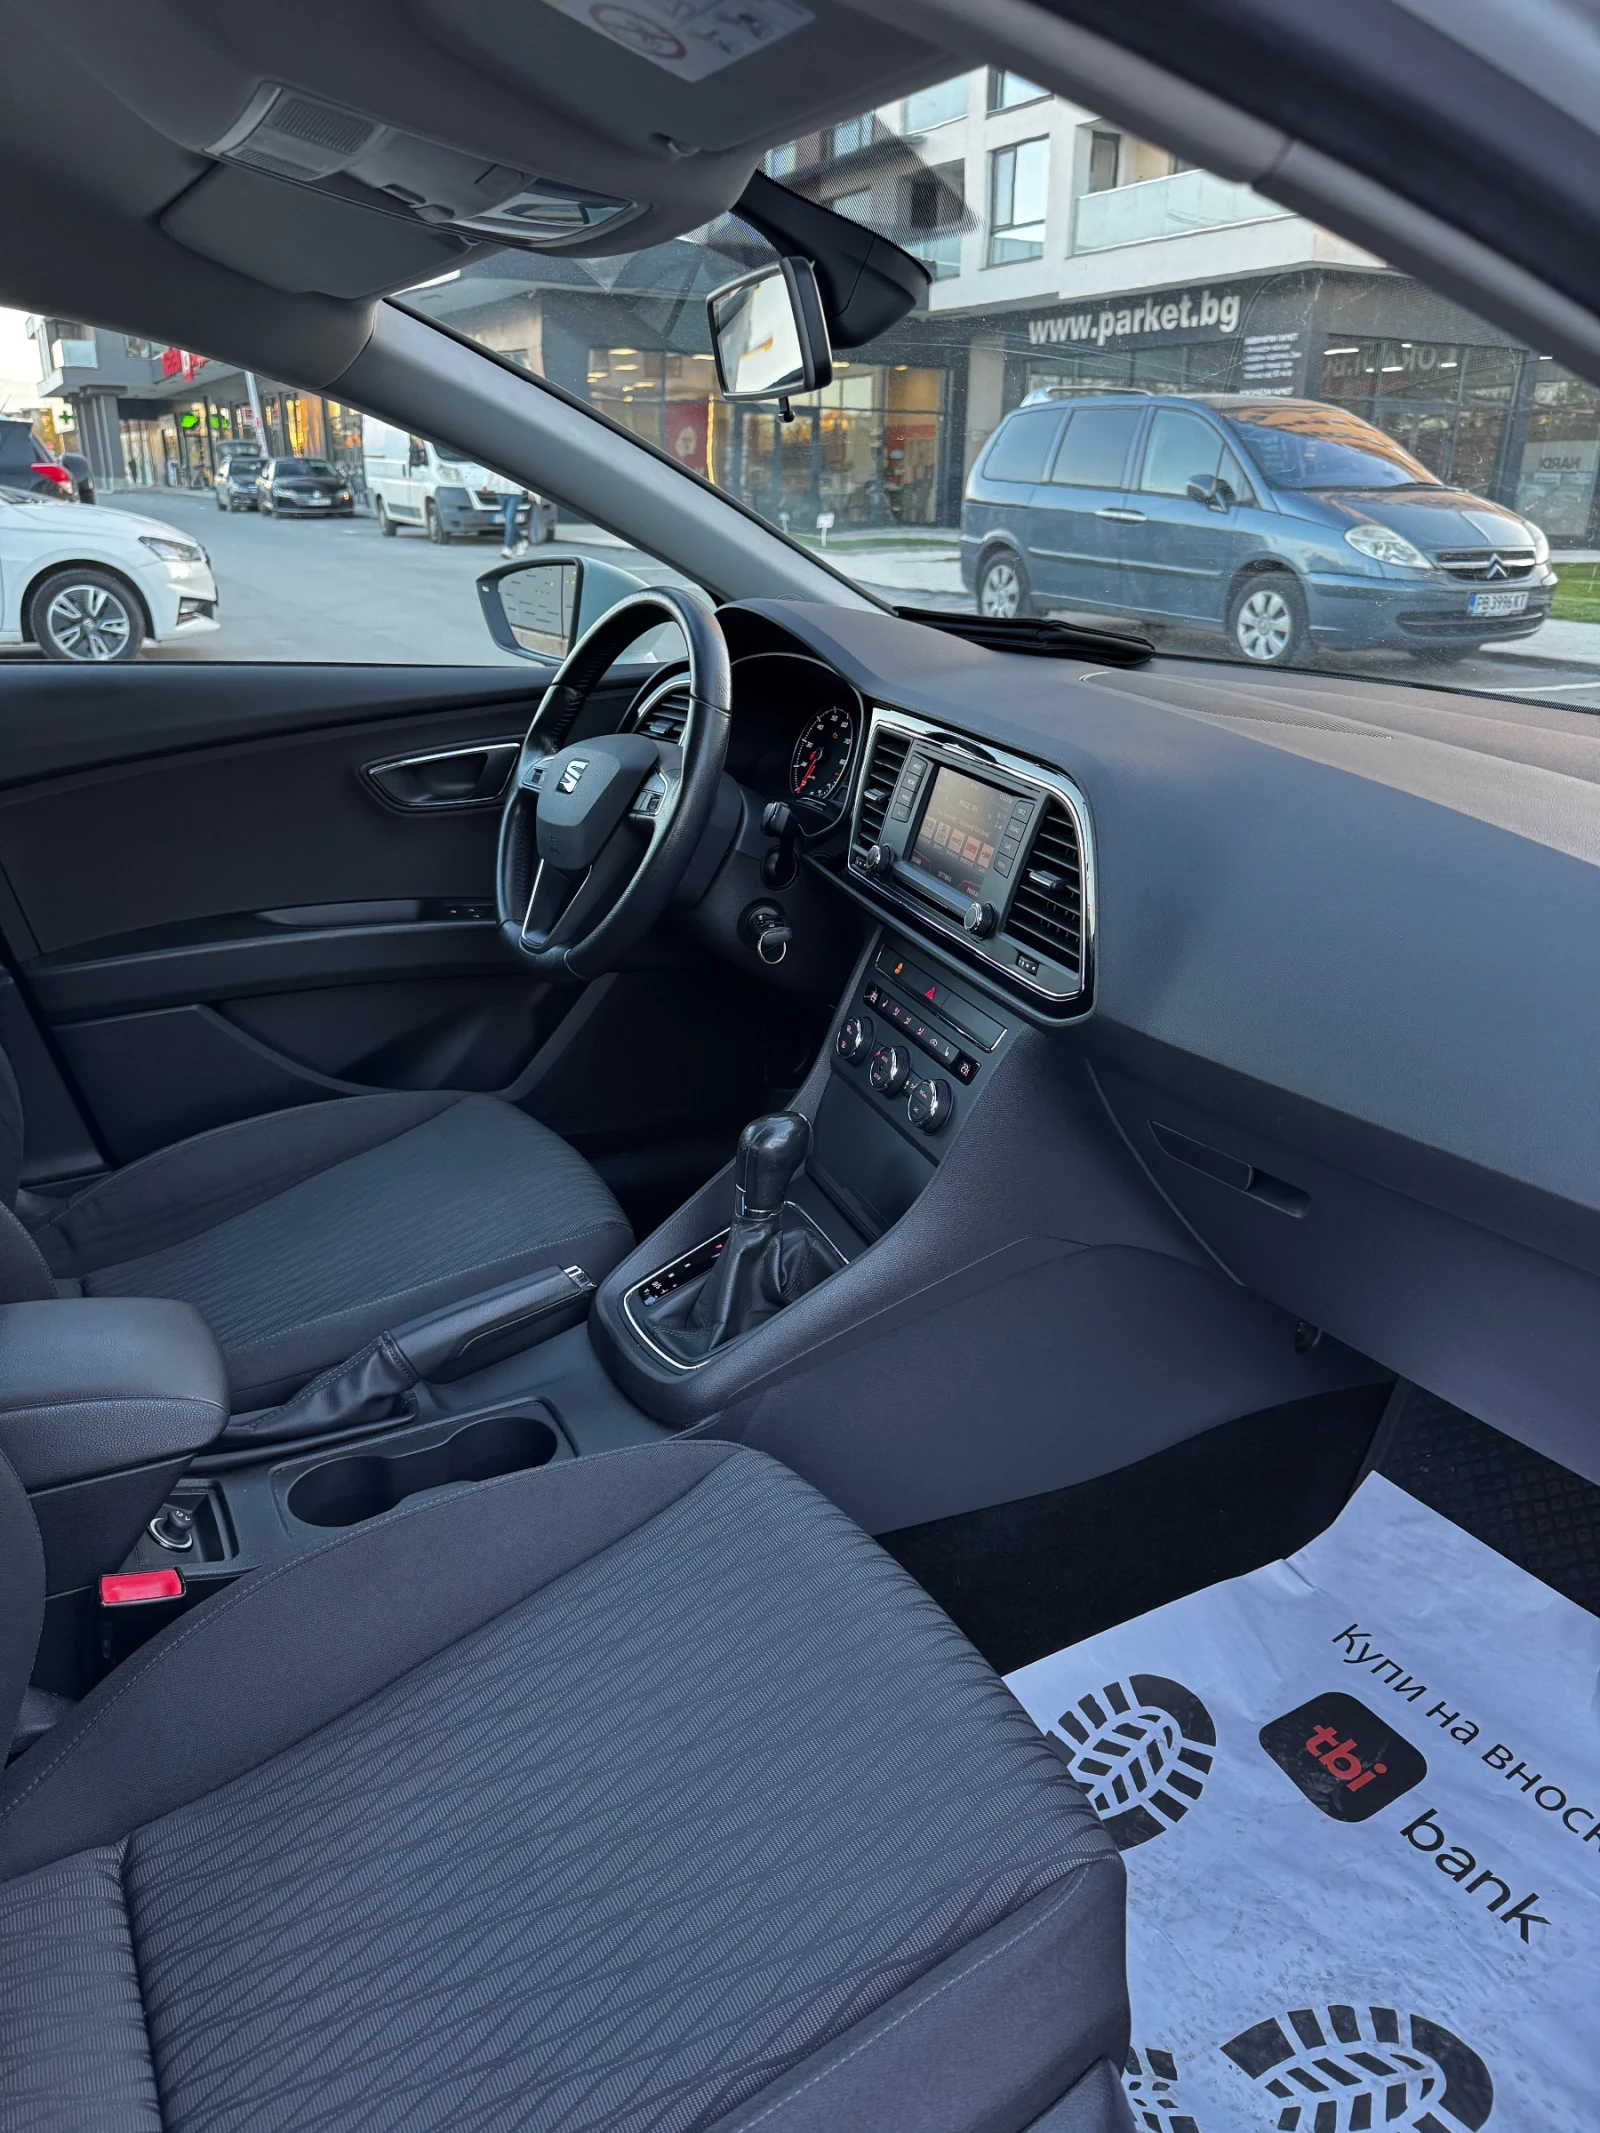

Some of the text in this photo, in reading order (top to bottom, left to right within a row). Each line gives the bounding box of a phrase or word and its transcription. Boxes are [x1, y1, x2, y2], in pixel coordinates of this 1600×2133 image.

[1028, 289, 1241, 347] www.parket.bg
[1331, 1623, 1428, 1703] Купи
[1425, 1701, 1480, 1746] на
[1305, 1724, 1388, 1792] tbi
[1400, 1808, 1552, 1945] bank
